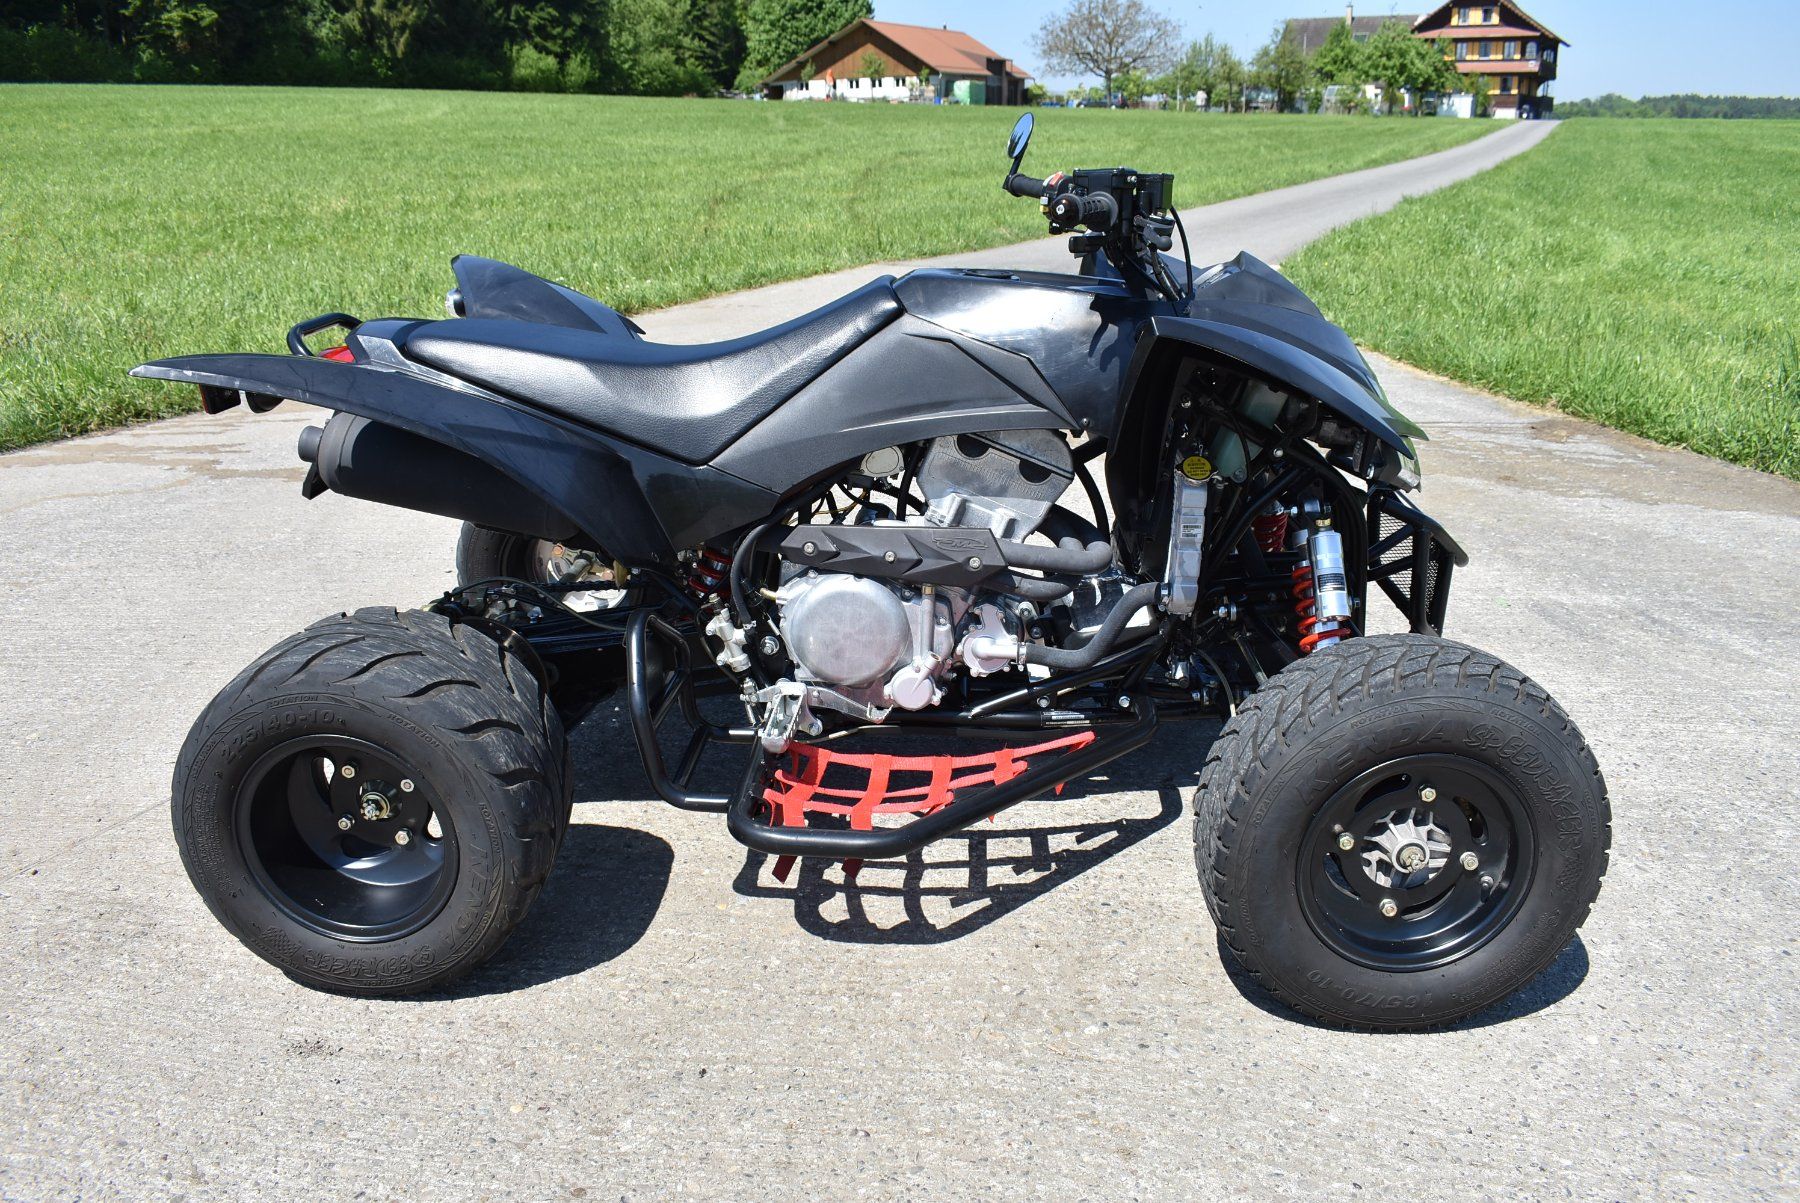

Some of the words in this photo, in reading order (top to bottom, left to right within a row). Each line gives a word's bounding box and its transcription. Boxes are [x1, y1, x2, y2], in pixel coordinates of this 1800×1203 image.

[267, 694, 319, 708] ROTATION
[1351, 703, 1408, 729] ROTATION
[220, 708, 336, 763] 225/40-10
[386, 712, 441, 749] ROTATION
[1296, 718, 1454, 806] KENDA
[1253, 777, 1284, 827] ROTATION
[478, 803, 502, 857] ROTATION
